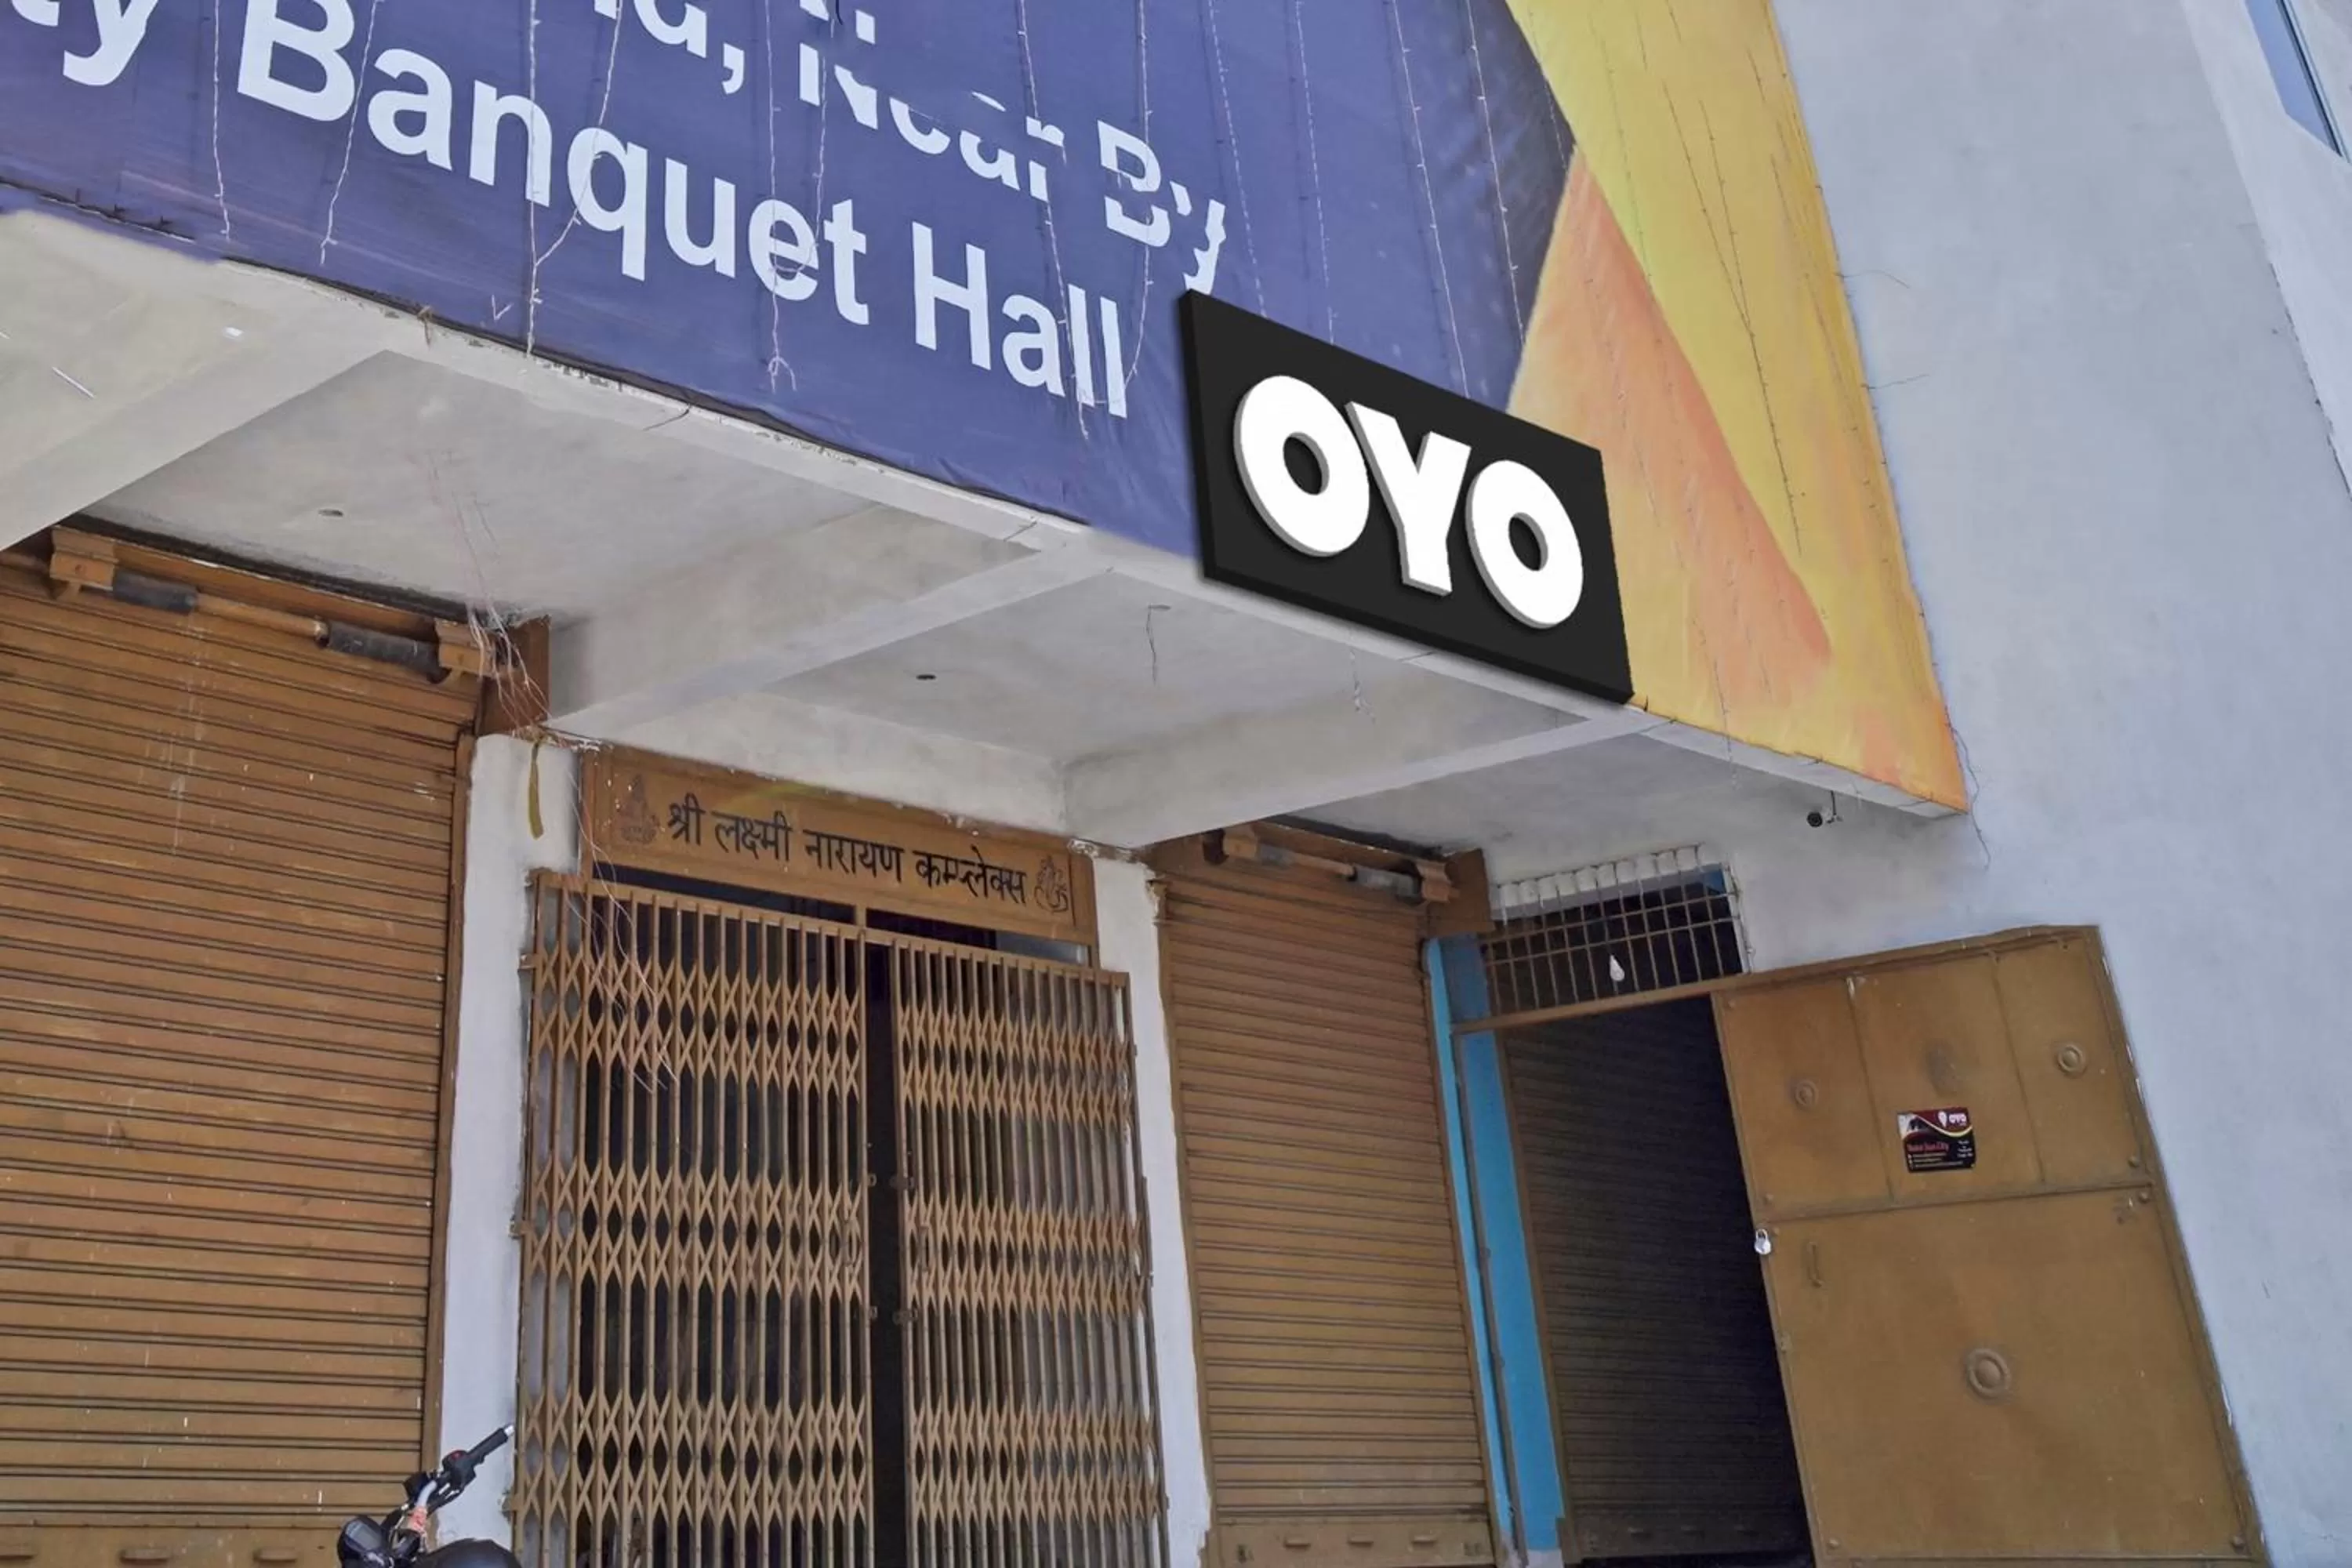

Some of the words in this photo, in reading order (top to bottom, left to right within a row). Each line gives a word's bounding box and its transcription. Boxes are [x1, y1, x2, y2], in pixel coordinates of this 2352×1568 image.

[237, 0, 869, 325] Banquet
[911, 221, 1127, 419] Hall
[1233, 375, 1584, 630] OYO
[668, 793, 706, 846] श्री
[711, 810, 793, 862] लक्ष्मी
[803, 829, 904, 883] नारायण
